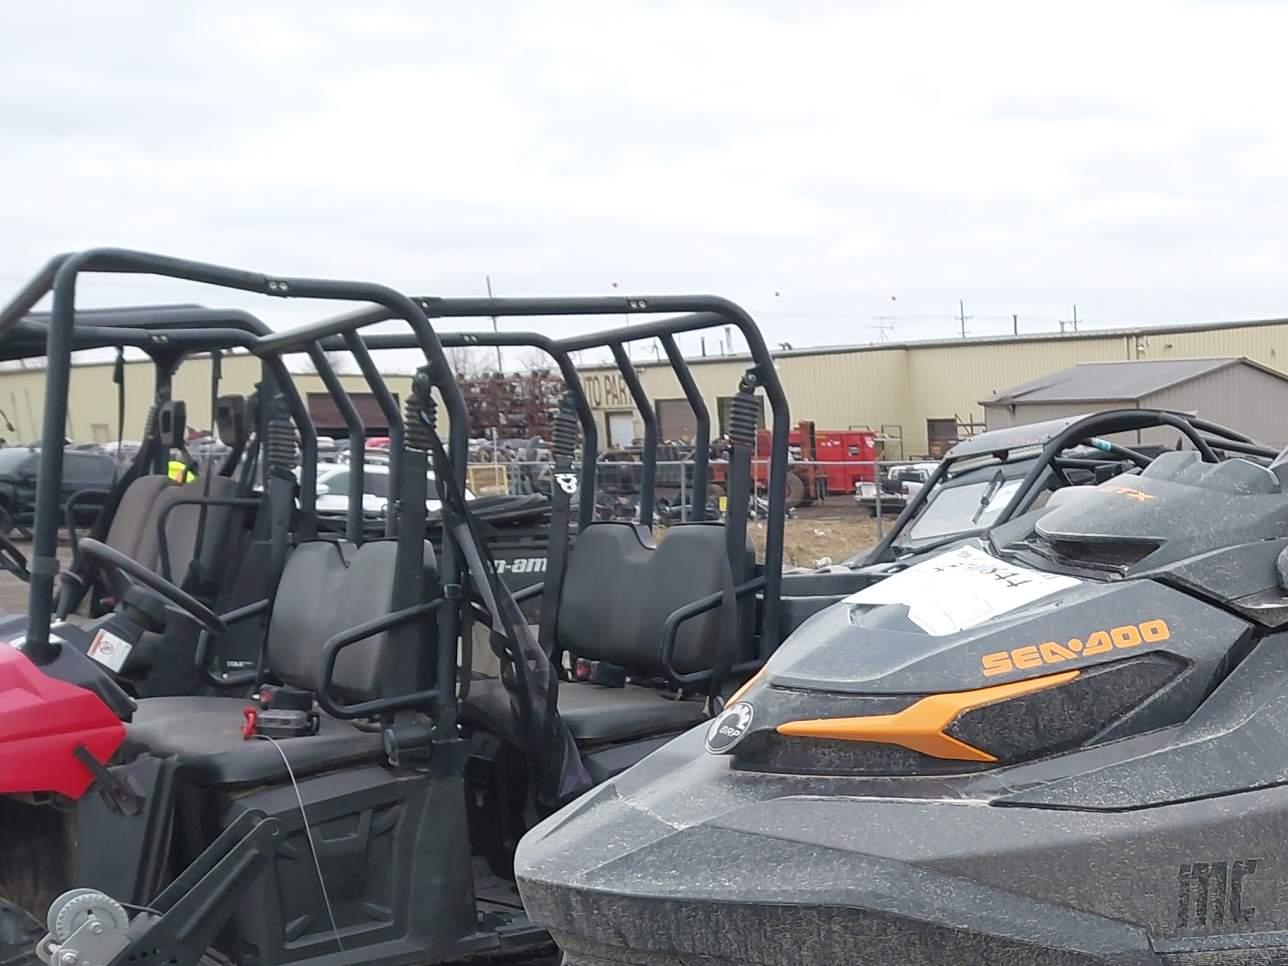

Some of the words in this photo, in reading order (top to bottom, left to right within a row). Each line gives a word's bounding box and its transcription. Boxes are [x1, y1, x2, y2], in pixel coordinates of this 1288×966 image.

[604, 374, 633, 405] PAR
[719, 725, 741, 737] BRP
[1177, 858, 1260, 928] MC
